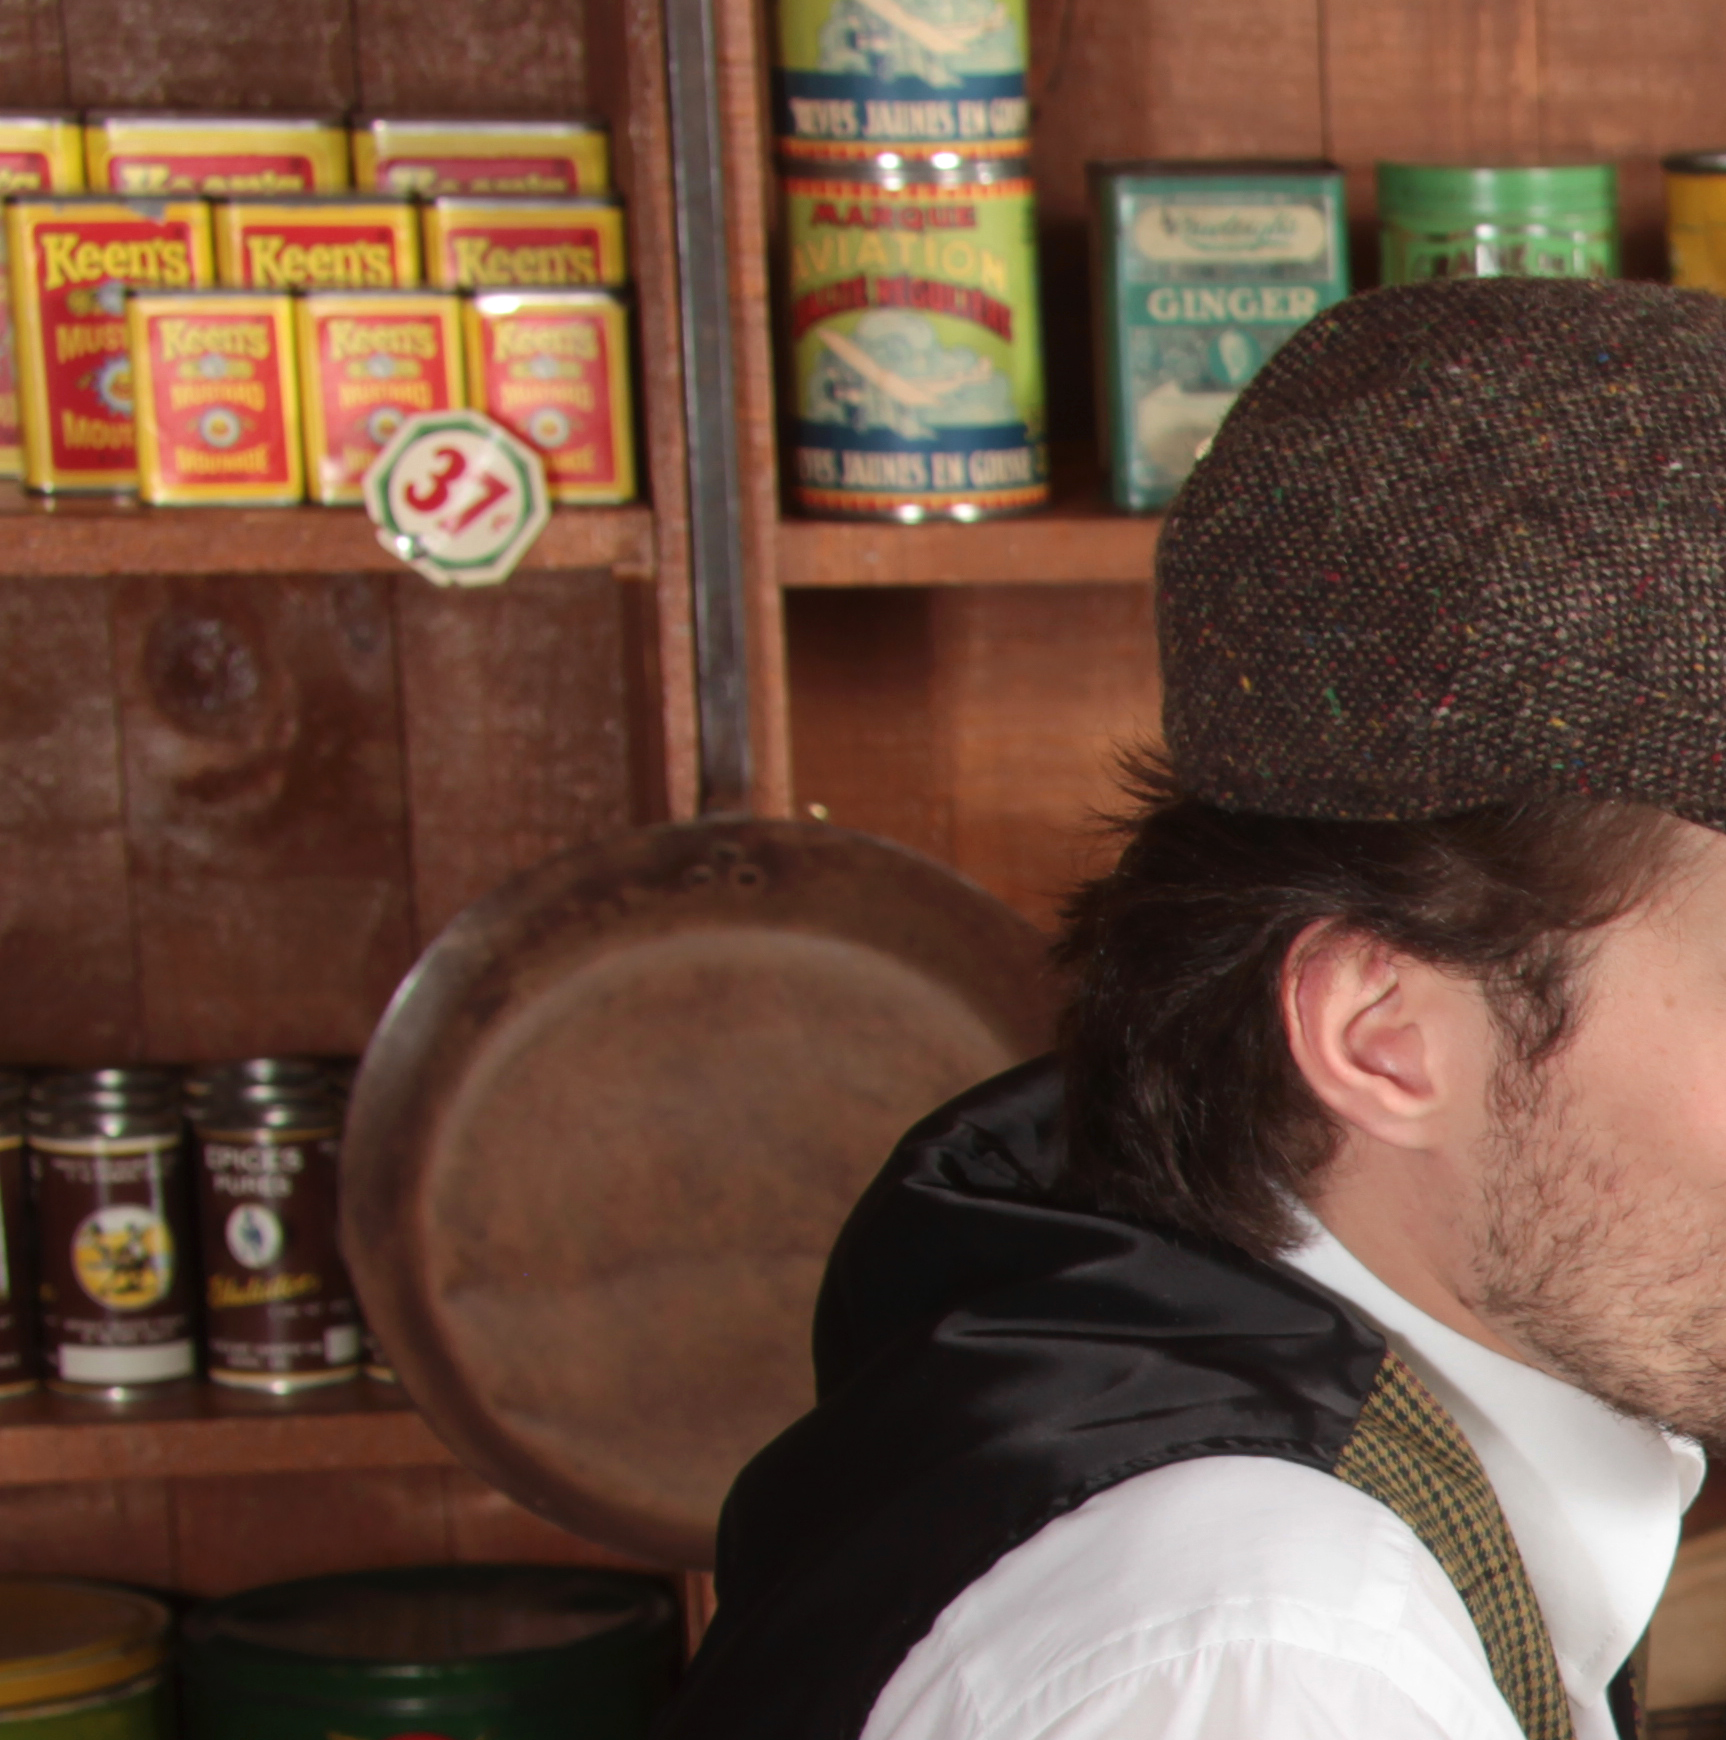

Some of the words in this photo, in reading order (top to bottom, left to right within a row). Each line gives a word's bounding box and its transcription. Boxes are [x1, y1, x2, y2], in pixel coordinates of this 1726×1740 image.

[810, 203, 979, 231] MARQUE
[39, 232, 191, 292] Keen's
[245, 234, 391, 287] Keen's
[1146, 286, 1320, 324] GINGER
